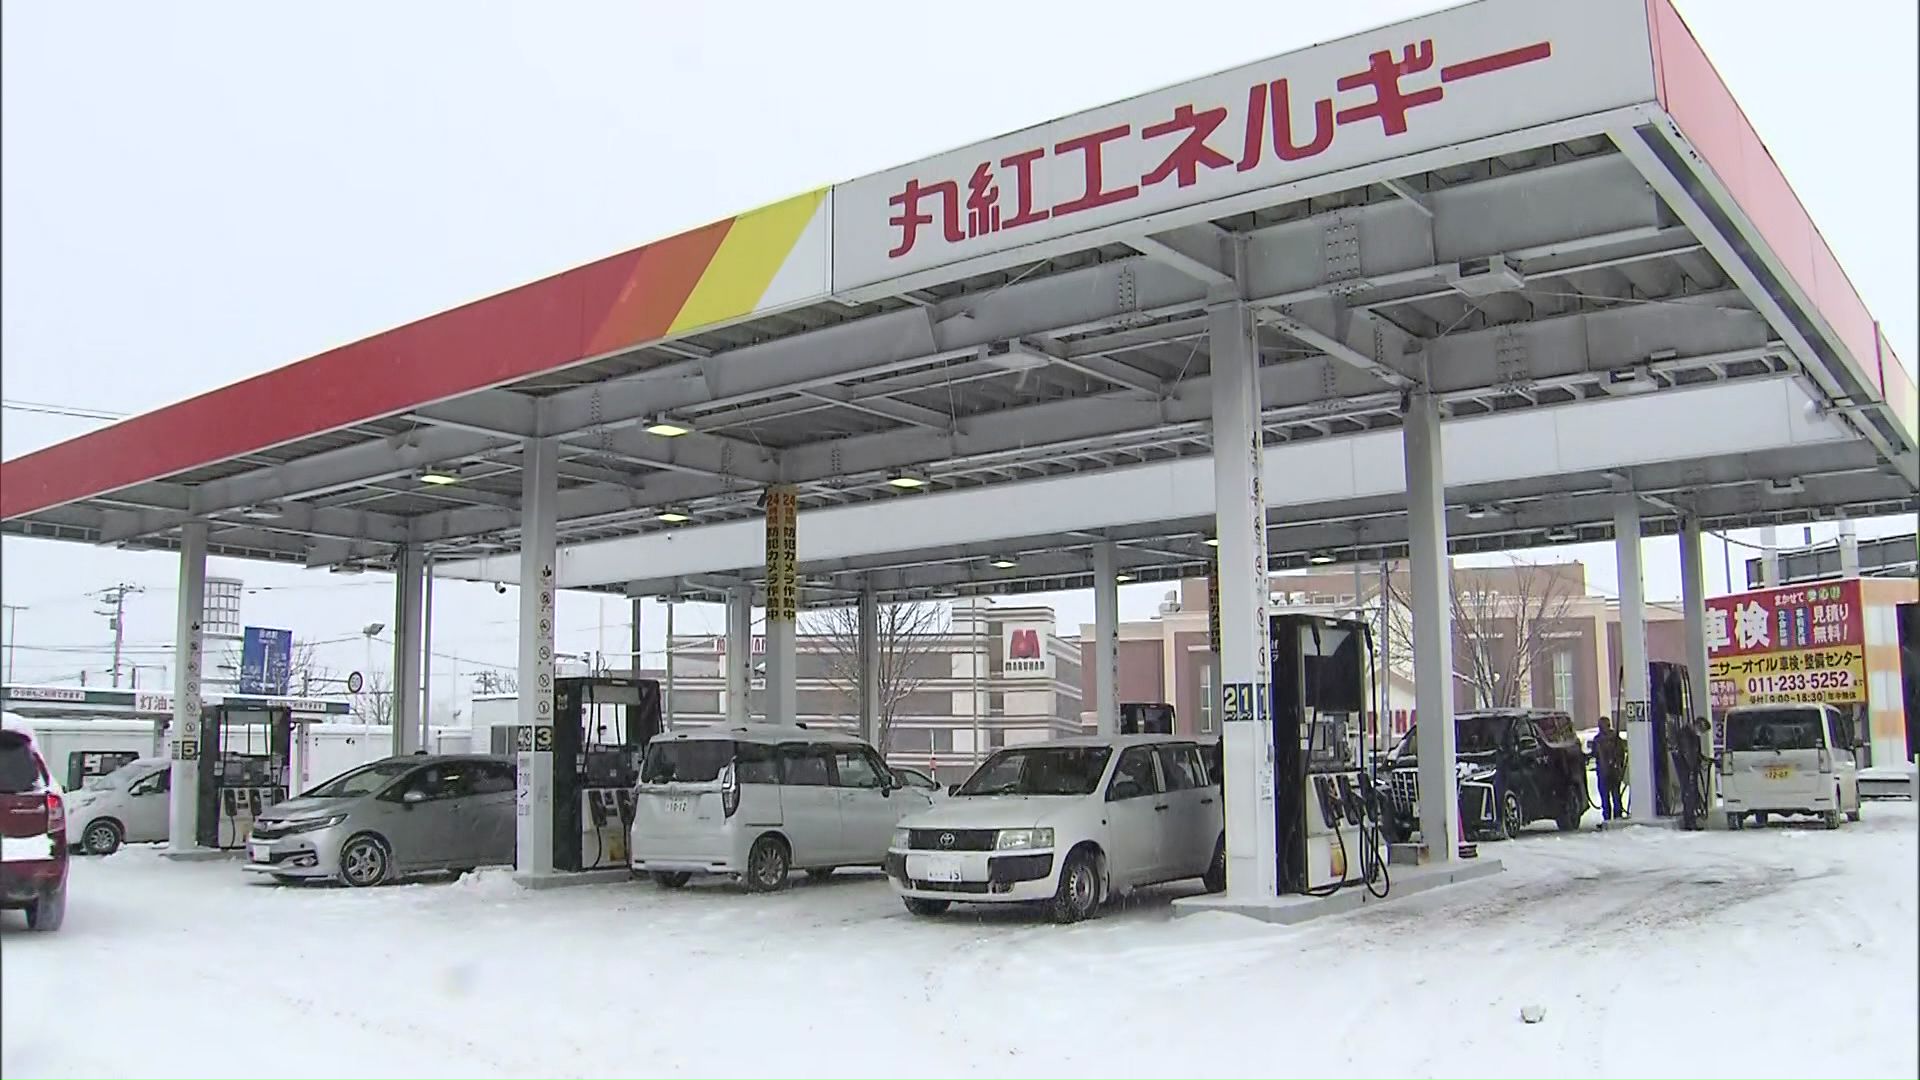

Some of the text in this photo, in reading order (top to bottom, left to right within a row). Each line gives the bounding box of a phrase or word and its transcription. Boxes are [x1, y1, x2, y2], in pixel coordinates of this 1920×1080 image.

[888, 38, 1552, 258] 丸紅エネルギー
[1813, 603, 1849, 624] 見積り
[1705, 600, 1771, 652] 車検
[1749, 671, 1849, 693] 011-233-5252
[1224, 687, 1237, 712] 2
[1241, 686, 1250, 711] 1
[536, 727, 552, 746] 3
[183, 743, 196, 756] 5
